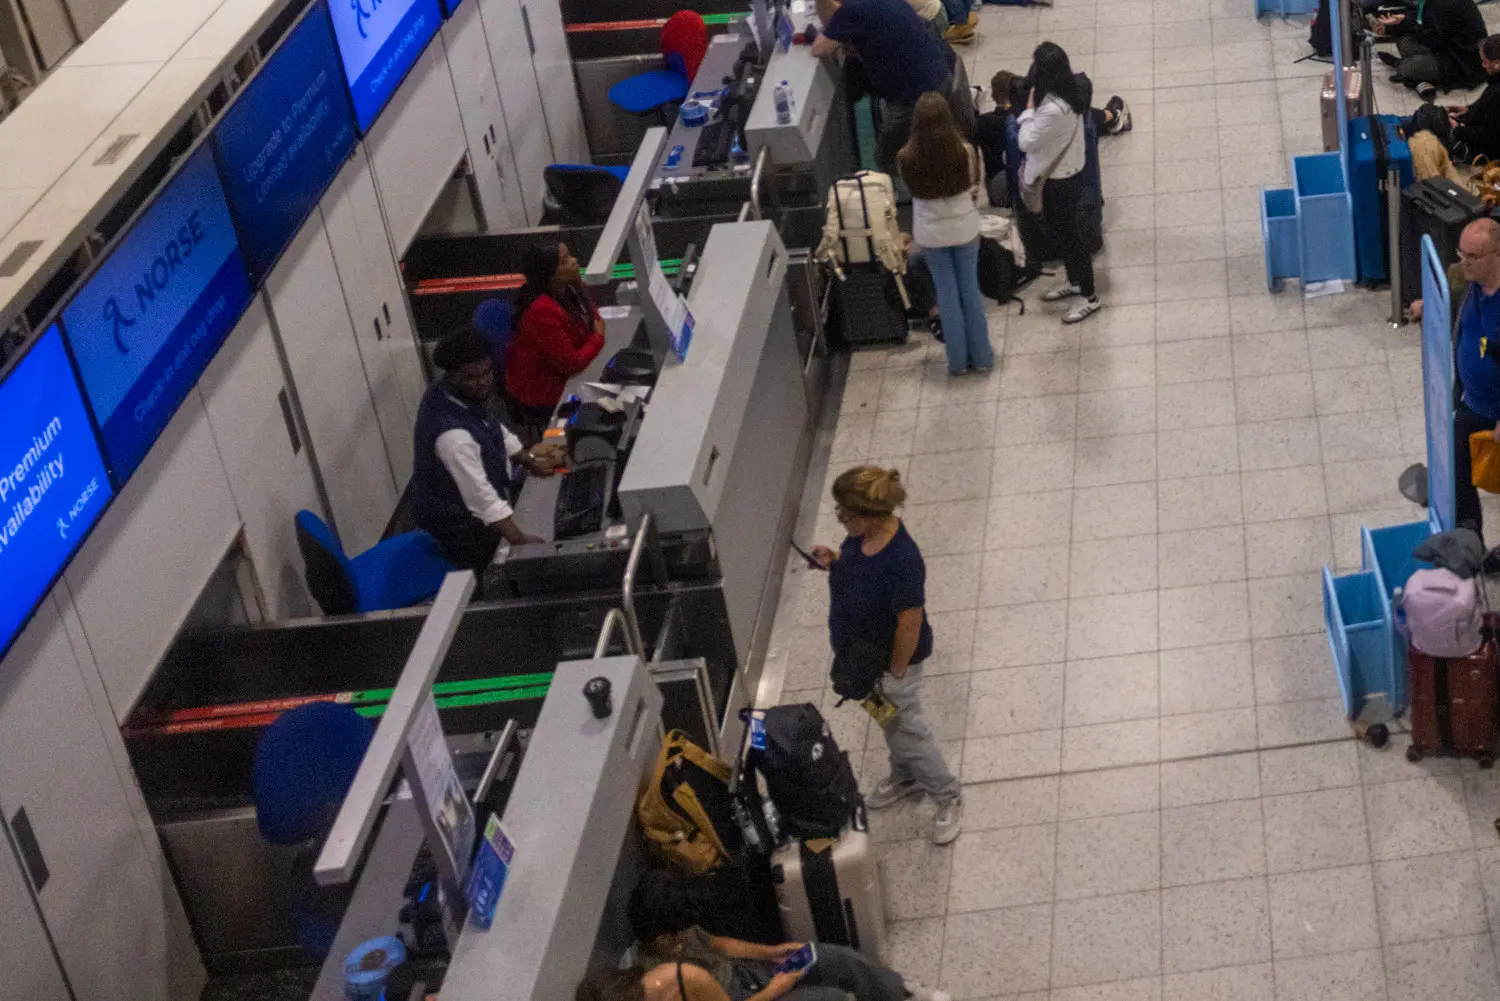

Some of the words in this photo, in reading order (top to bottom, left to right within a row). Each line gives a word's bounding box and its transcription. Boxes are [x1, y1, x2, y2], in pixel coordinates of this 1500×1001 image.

[134, 210, 206, 313] NORSE
[0, 416, 62, 501] Premium
[0, 453, 65, 554] vailability
[68, 477, 99, 522] NORSE
